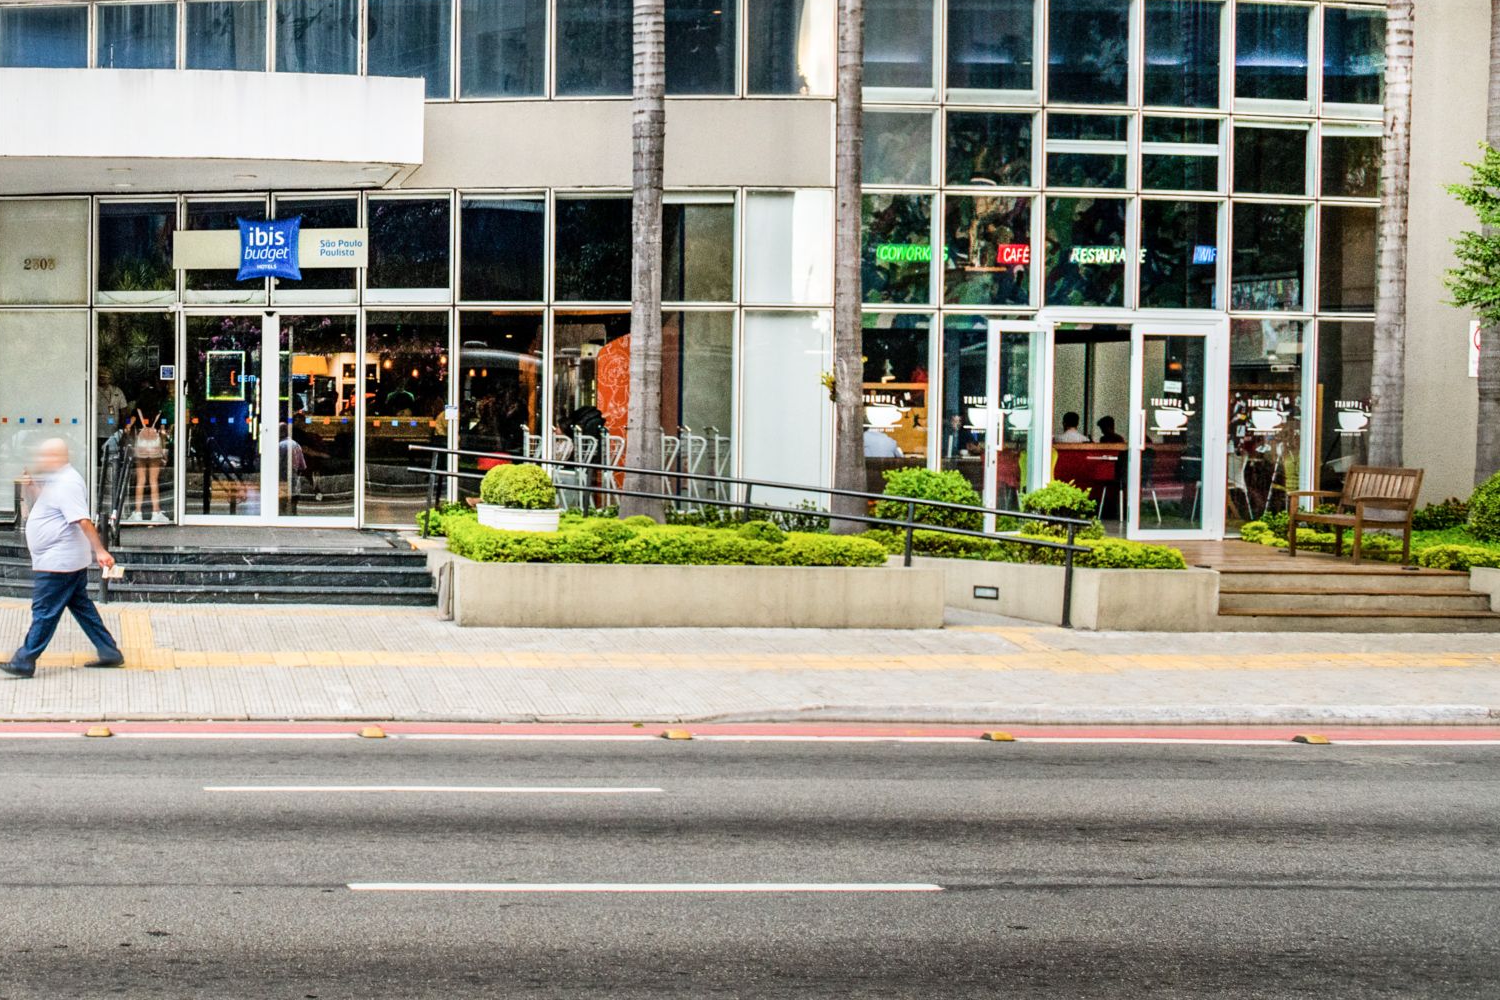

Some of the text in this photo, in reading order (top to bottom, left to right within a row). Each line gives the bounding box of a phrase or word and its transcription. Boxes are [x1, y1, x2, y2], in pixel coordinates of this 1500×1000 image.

[248, 227, 285, 246] ibis
[320, 239, 363, 248] São Paulo
[244, 246, 289, 262] budget
[320, 248, 355, 257] Paulista
